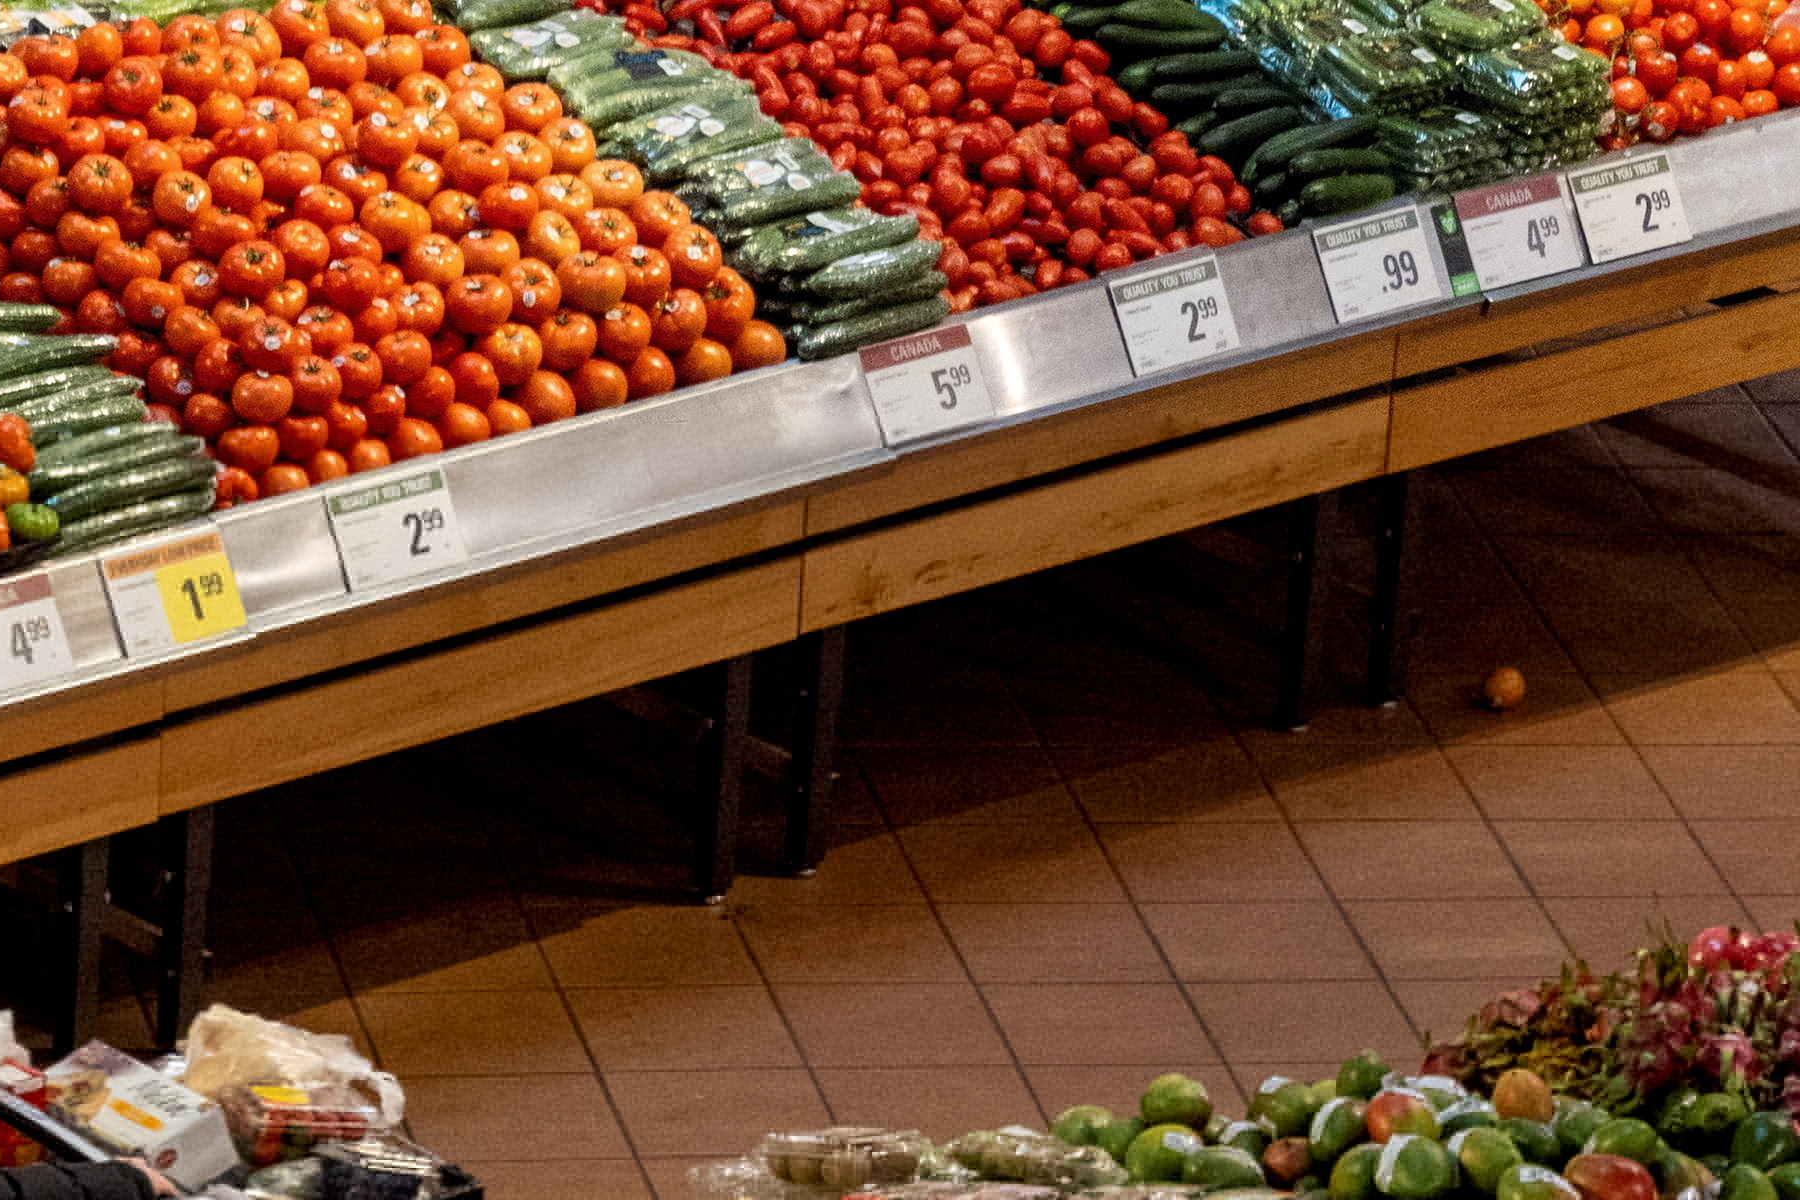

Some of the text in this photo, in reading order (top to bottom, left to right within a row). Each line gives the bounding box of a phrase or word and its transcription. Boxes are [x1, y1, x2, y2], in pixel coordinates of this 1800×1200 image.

[1581, 159, 1660, 190] QUALITY YOU TRUST
[1485, 186, 1534, 212] CANADA
[1326, 214, 1408, 249] QUALITY YOU TRUST
[1122, 265, 1207, 300] QUALITY YOU TRUST
[1382, 250, 1419, 293] .99
[890, 335, 942, 361] CANADA
